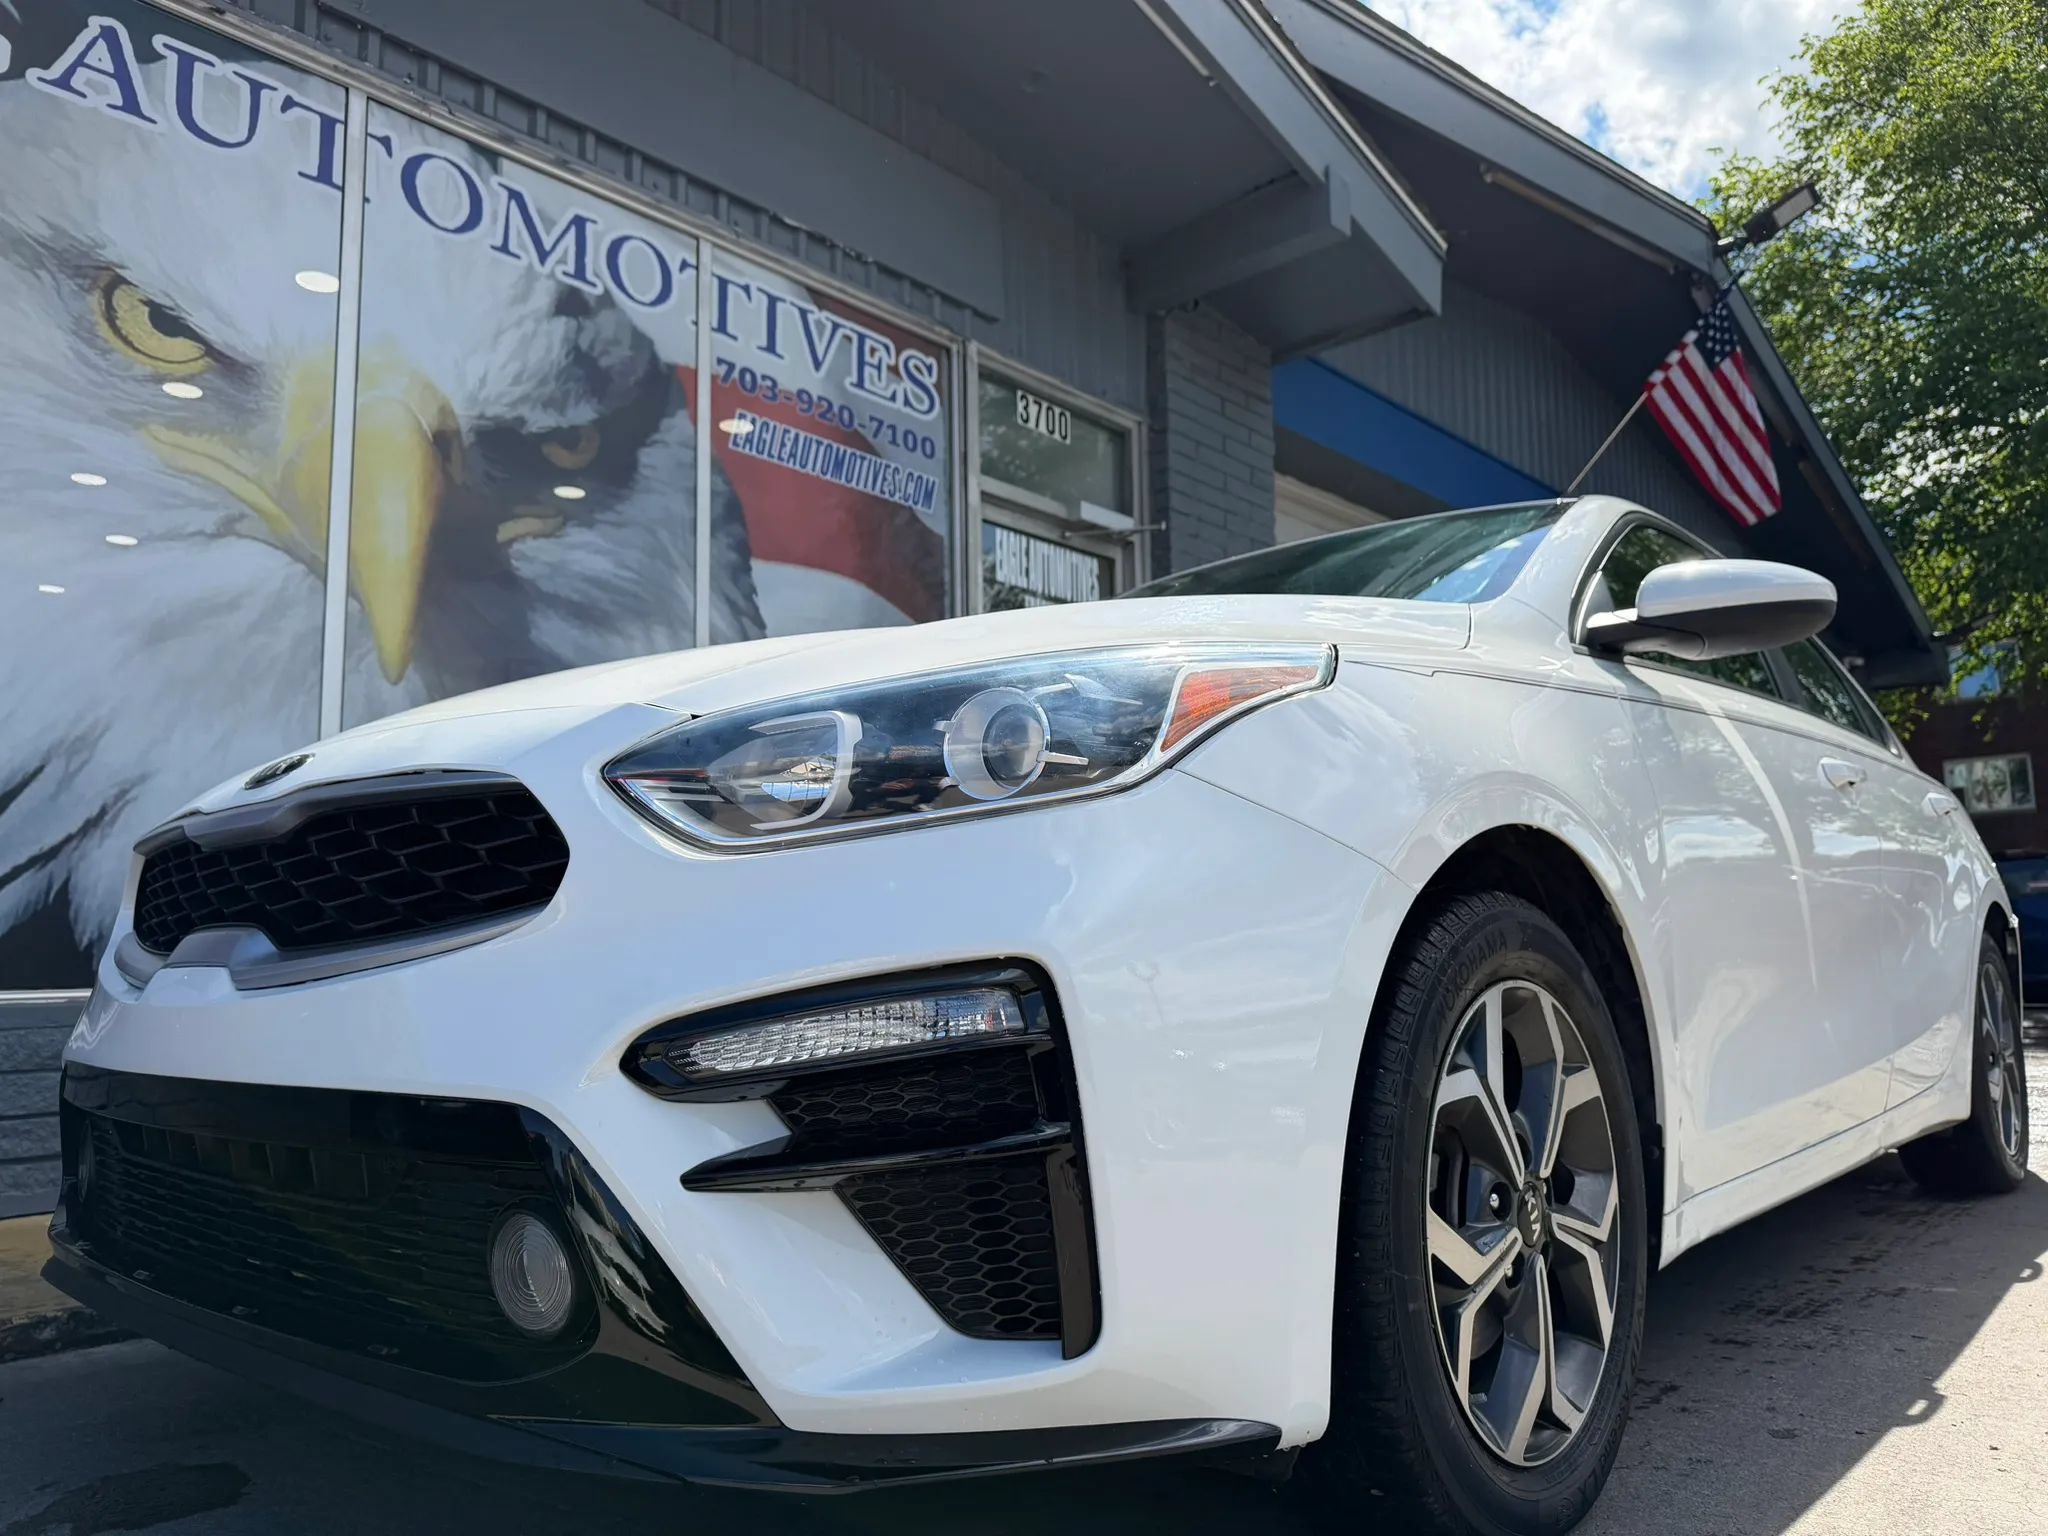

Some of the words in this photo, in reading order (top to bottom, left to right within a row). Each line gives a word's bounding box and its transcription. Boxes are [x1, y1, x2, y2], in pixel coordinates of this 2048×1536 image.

[34, 22, 938, 416] AUTOMOTIVES
[716, 356, 936, 460] 703-920-7100
[1019, 393, 1068, 441] 3700
